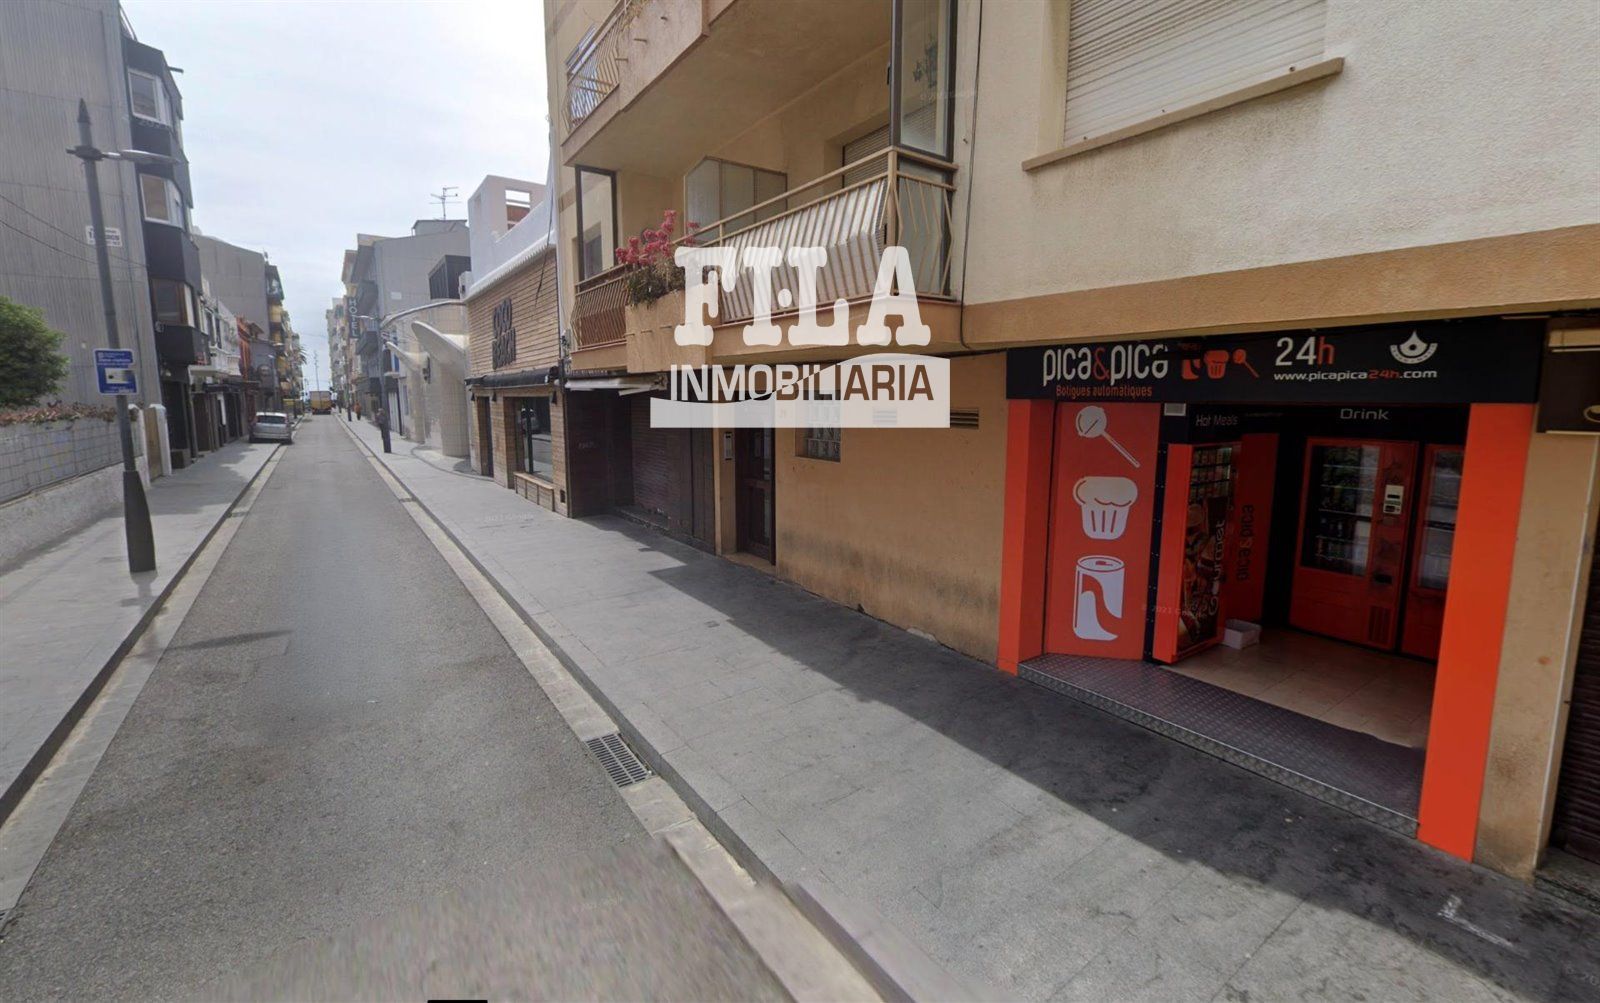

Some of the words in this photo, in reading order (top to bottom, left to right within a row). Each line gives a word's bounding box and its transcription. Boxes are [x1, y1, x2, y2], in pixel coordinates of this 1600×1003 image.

[1275, 336, 1335, 367] 24h
[1043, 344, 1169, 387] pica&pica
[1273, 370, 1438, 382] www.picapica24h.com
[1340, 407, 1389, 420] Drink
